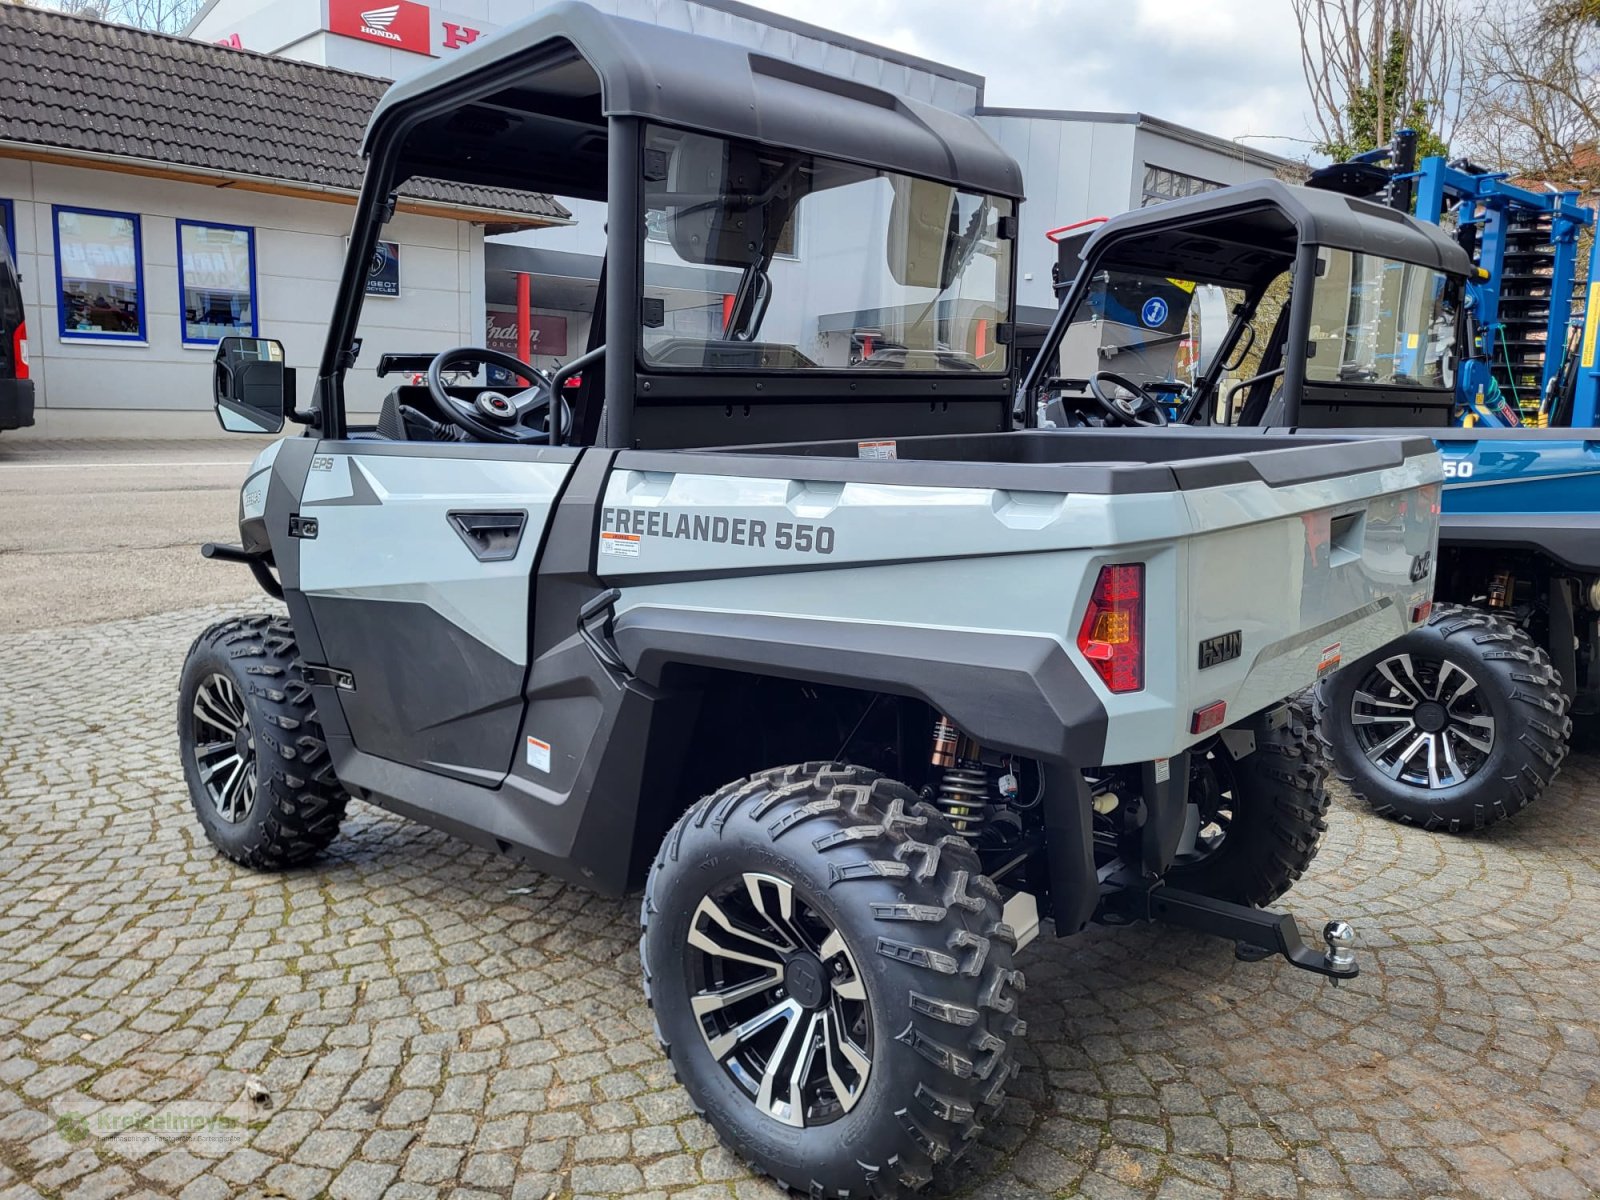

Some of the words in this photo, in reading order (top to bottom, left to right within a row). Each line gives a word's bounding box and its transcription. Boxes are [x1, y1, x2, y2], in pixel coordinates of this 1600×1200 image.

[361, 26, 402, 42] HONDA
[486, 316, 540, 342] Indin
[311, 457, 334, 472] EPS
[602, 507, 767, 548] FREELANDER
[775, 522, 835, 555] 550
